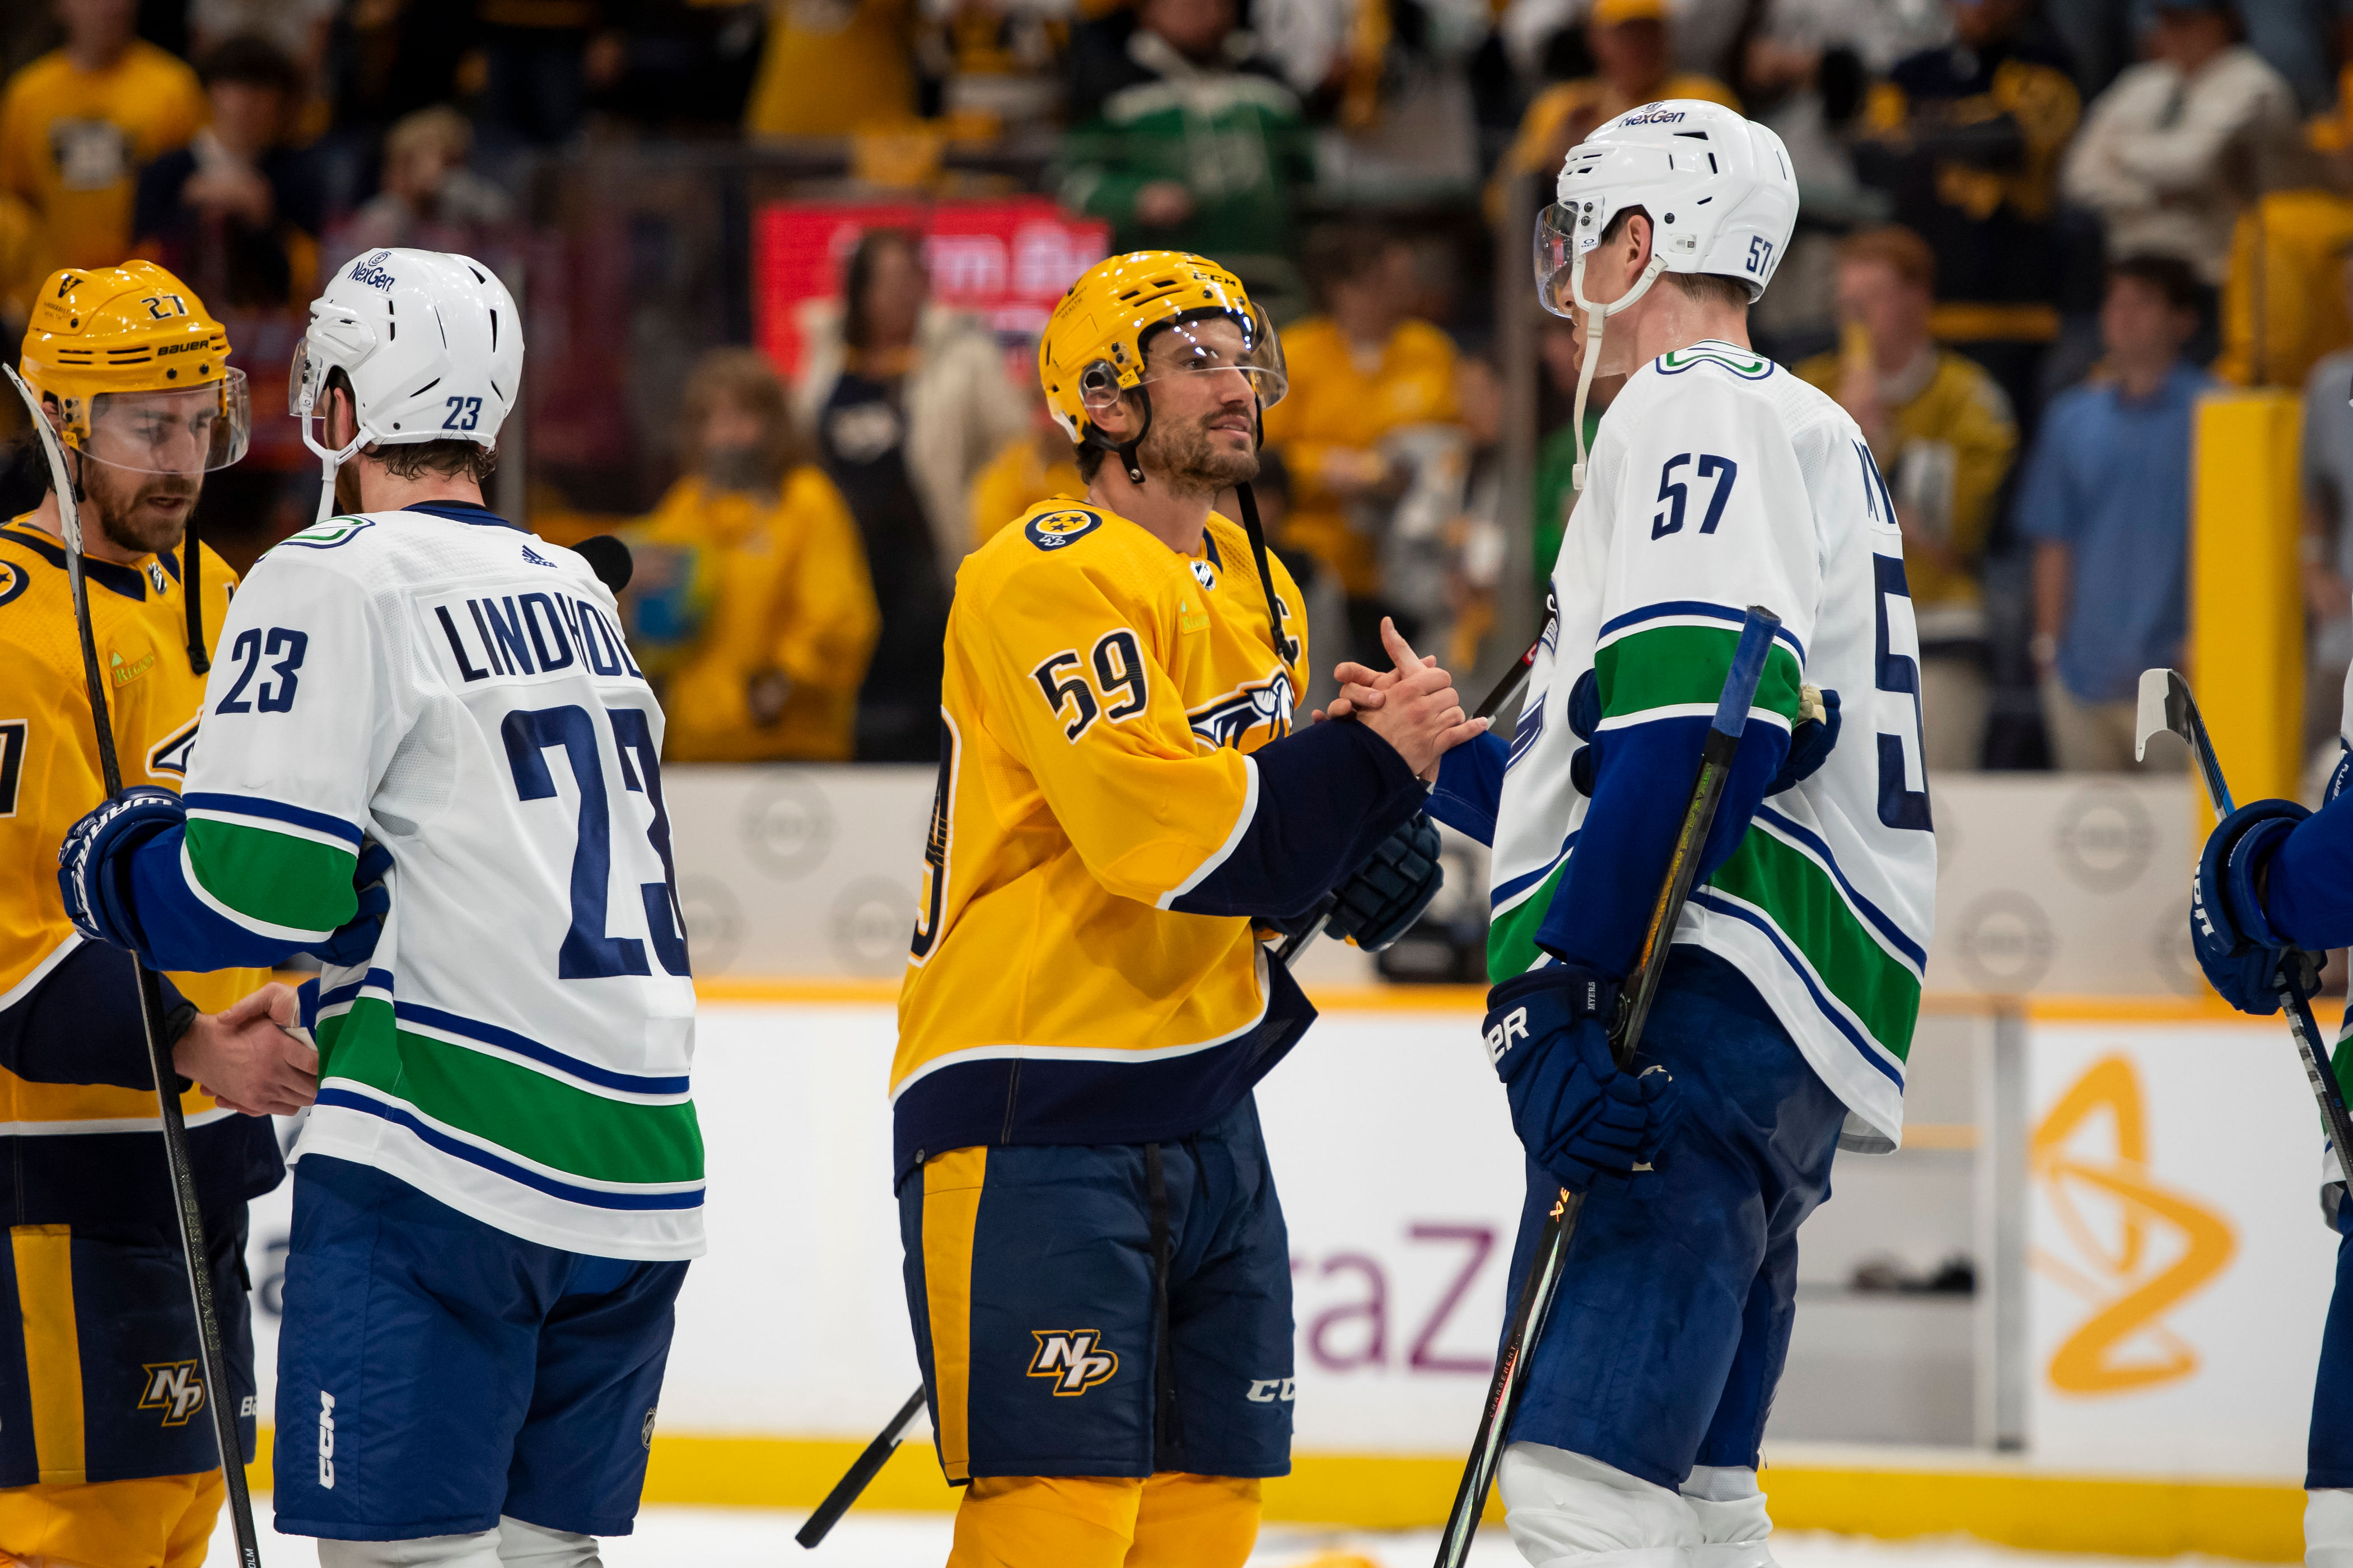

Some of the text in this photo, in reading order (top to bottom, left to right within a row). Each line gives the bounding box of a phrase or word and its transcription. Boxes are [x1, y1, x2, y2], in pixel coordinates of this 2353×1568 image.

[1618, 110, 1686, 128] NexGen
[347, 261, 395, 292] NexGen
[1746, 235, 1773, 277] 57
[140, 294, 189, 321] 27
[441, 396, 483, 430] 23
[1651, 453, 1738, 541] 57
[523, 558, 558, 568] adidas
[215, 626, 309, 715] 23
[1028, 627, 1149, 746] 59
[500, 704, 693, 980] 23
[1588, 981, 1596, 1011] MYERS
[1484, 1007, 1530, 1070] ER
[138, 1359, 205, 1427] NP
[1026, 1329, 1119, 1396] NP
[318, 1390, 335, 1490] CCM
